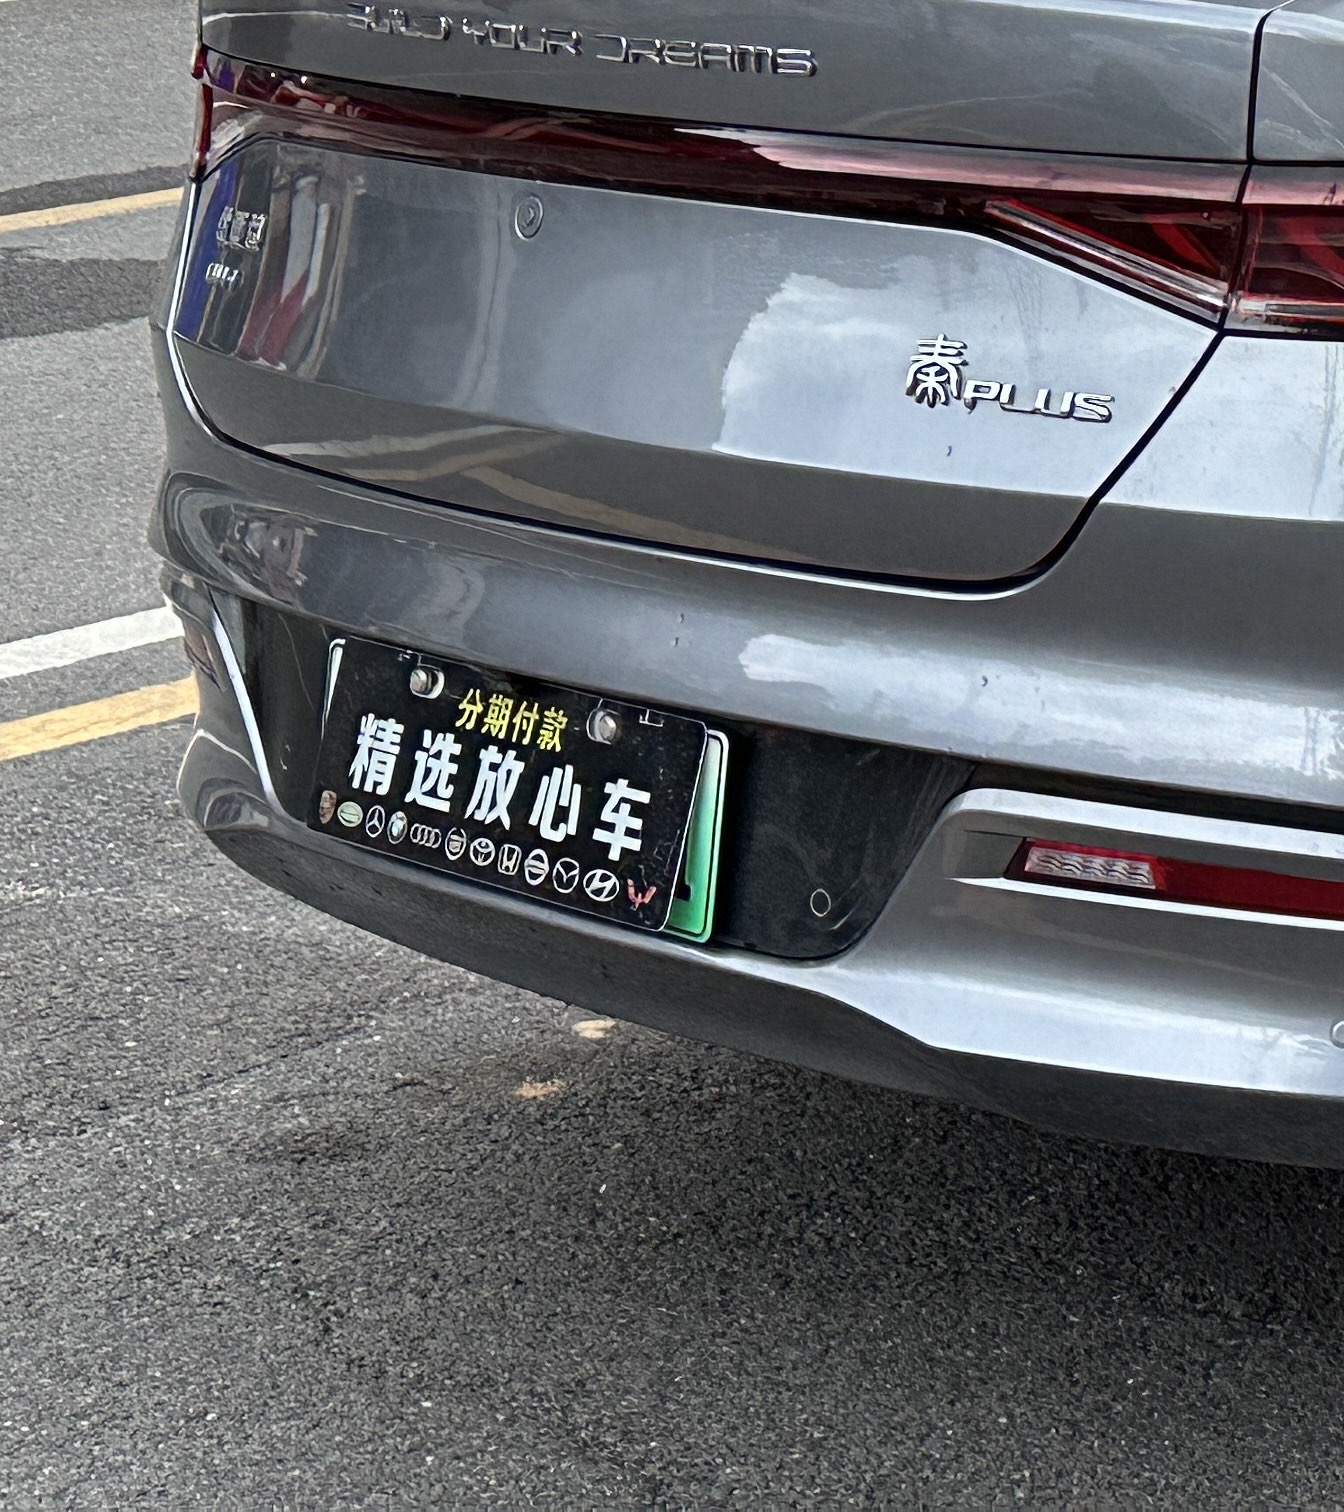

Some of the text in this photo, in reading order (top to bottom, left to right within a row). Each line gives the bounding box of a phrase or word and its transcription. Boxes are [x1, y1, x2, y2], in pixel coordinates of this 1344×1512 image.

[462, 19, 584, 56] YOUR
[594, 33, 818, 77] DREAMS
[454, 688, 569, 753] 分期付款
[348, 712, 651, 862] 精选放心车
